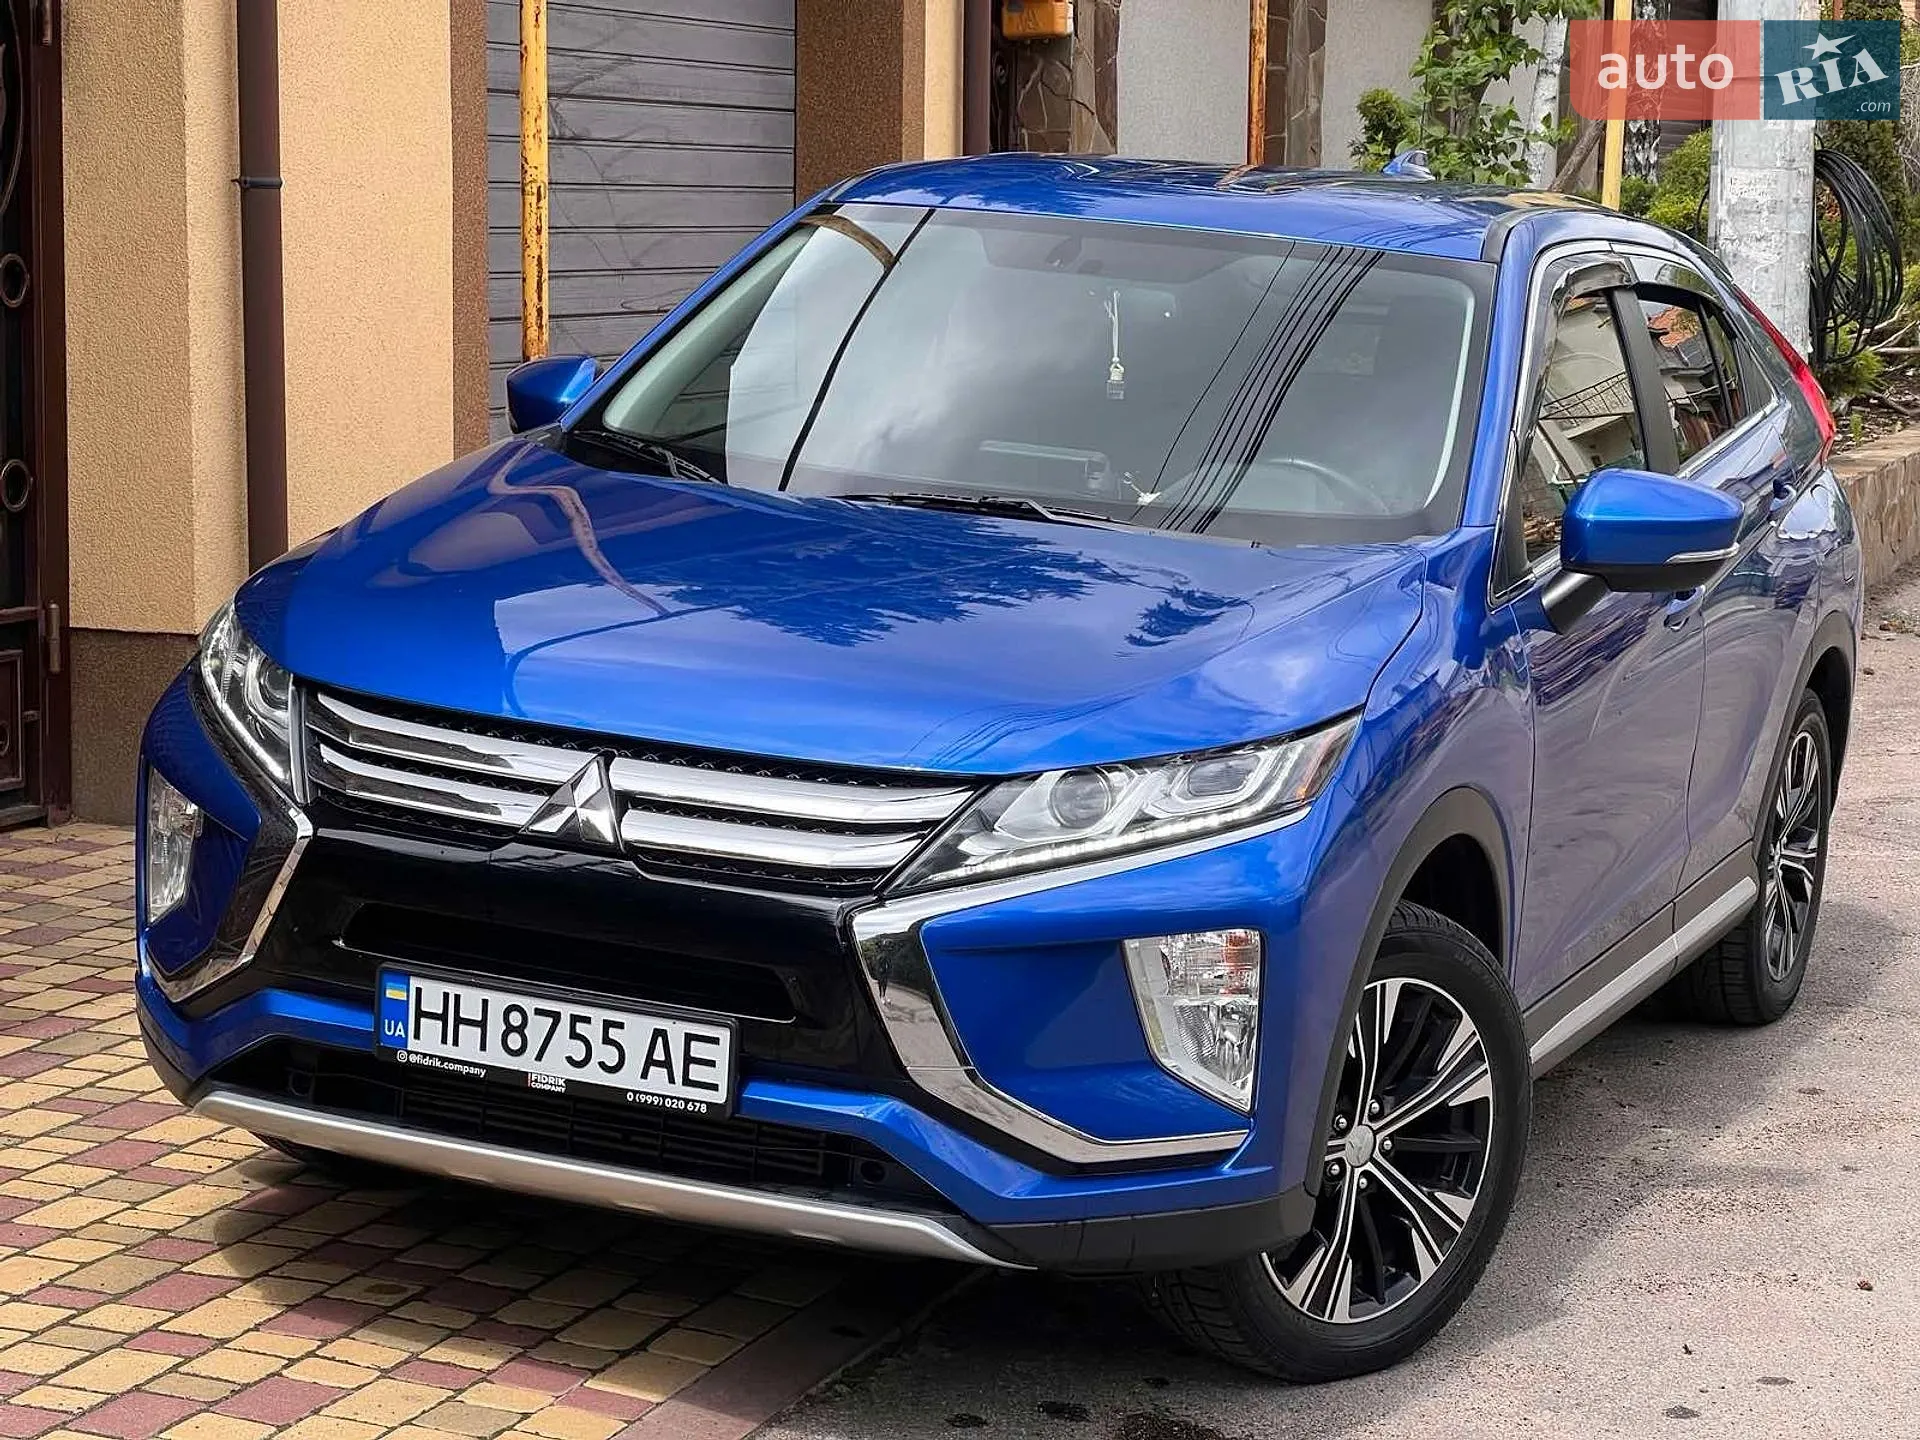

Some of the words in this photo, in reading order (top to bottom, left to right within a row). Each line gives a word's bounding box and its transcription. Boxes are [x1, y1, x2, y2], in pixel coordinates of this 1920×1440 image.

[384, 1019, 406, 1038] UA
[413, 986, 489, 1052] HH
[500, 1003, 626, 1074] 8755
[640, 1027, 721, 1092] AE
[408, 1053, 487, 1078] @fidrik.company
[531, 1073, 566, 1087] FIDRIK
[626, 1091, 634, 1102] 0
[635, 1093, 663, 1106] (999)
[664, 1098, 685, 1110] 020
[686, 1101, 707, 1113] 678
